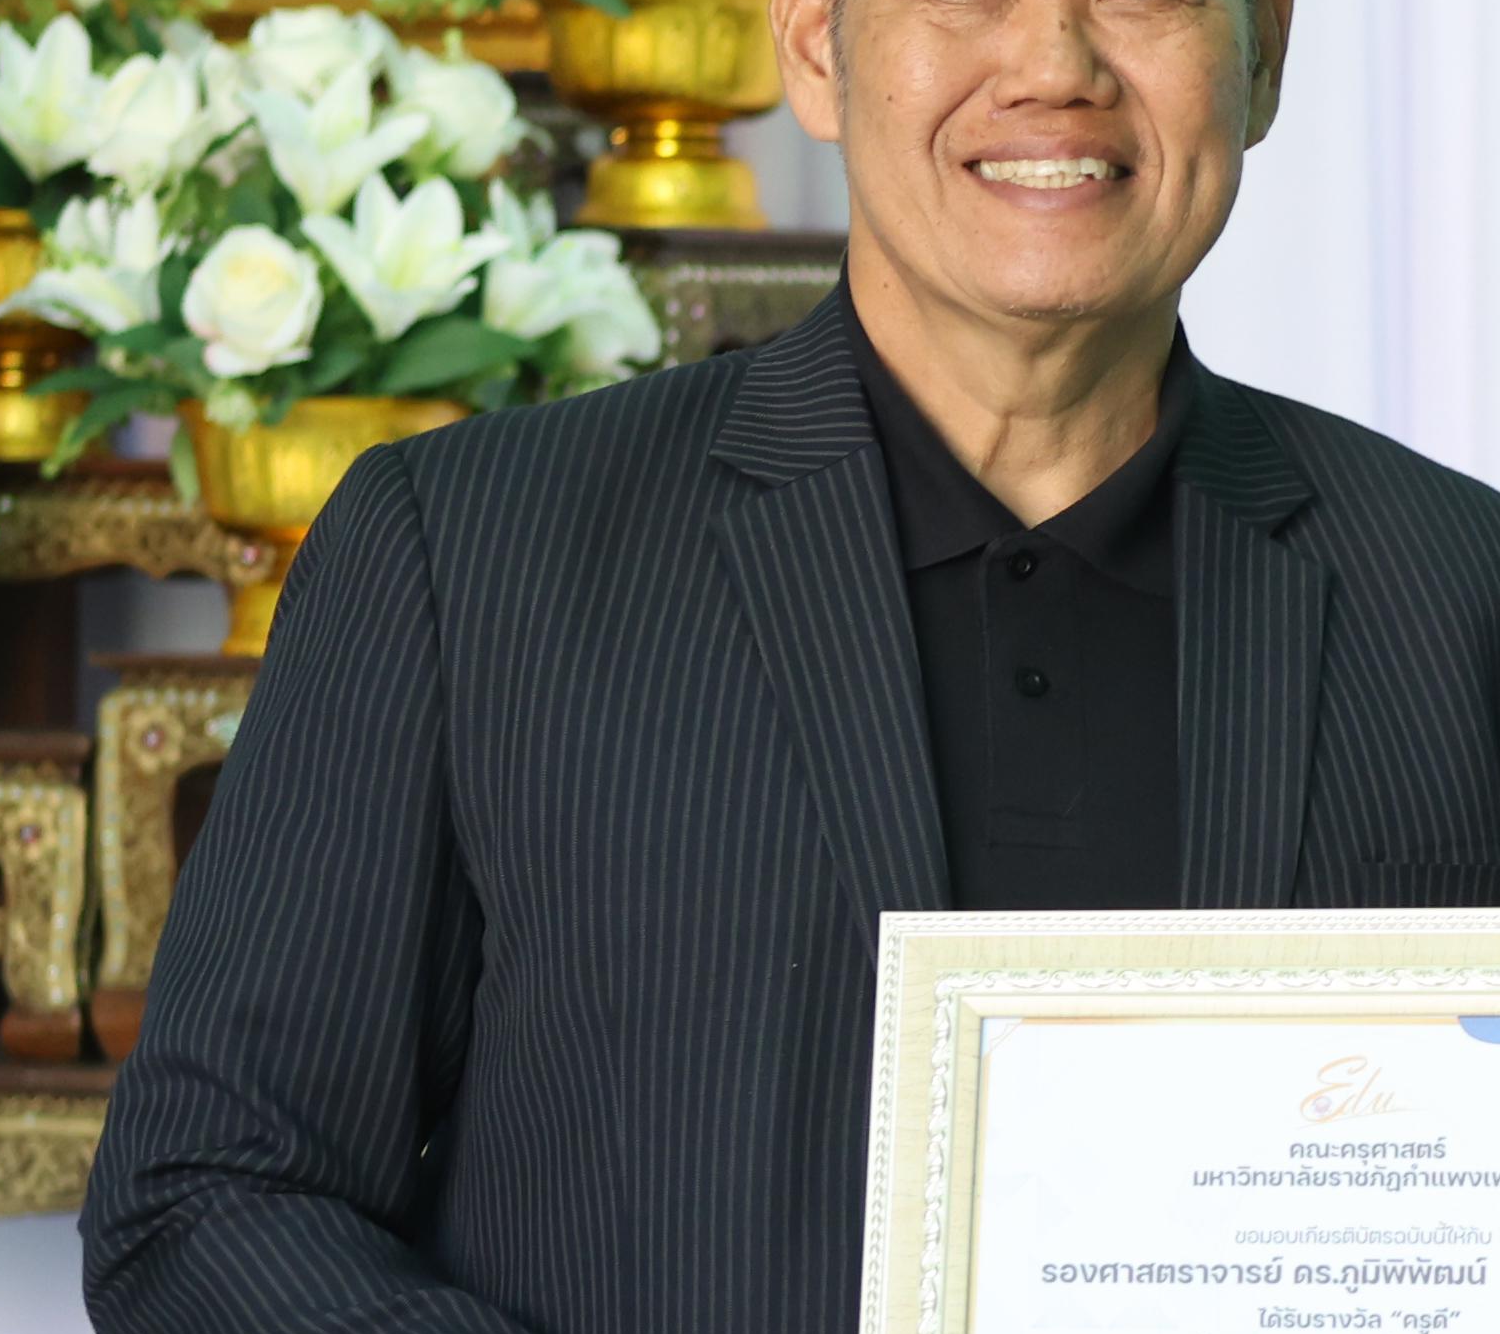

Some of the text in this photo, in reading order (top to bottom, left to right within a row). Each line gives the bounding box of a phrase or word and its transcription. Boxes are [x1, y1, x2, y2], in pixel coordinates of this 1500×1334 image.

[1289, 1136, 1447, 1165] คณะครุศาสตร์
[1234, 1220, 1493, 1246] ขอมอบเกียรติบัตรฉบับนี้ให้กับ
[1041, 1255, 1284, 1285] รองศาสตราจารย์
[1293, 1256, 1488, 1295] ดร.ภูมิพิพัฒน์
[1257, 1305, 1383, 1330] ได้รับรางวัล
